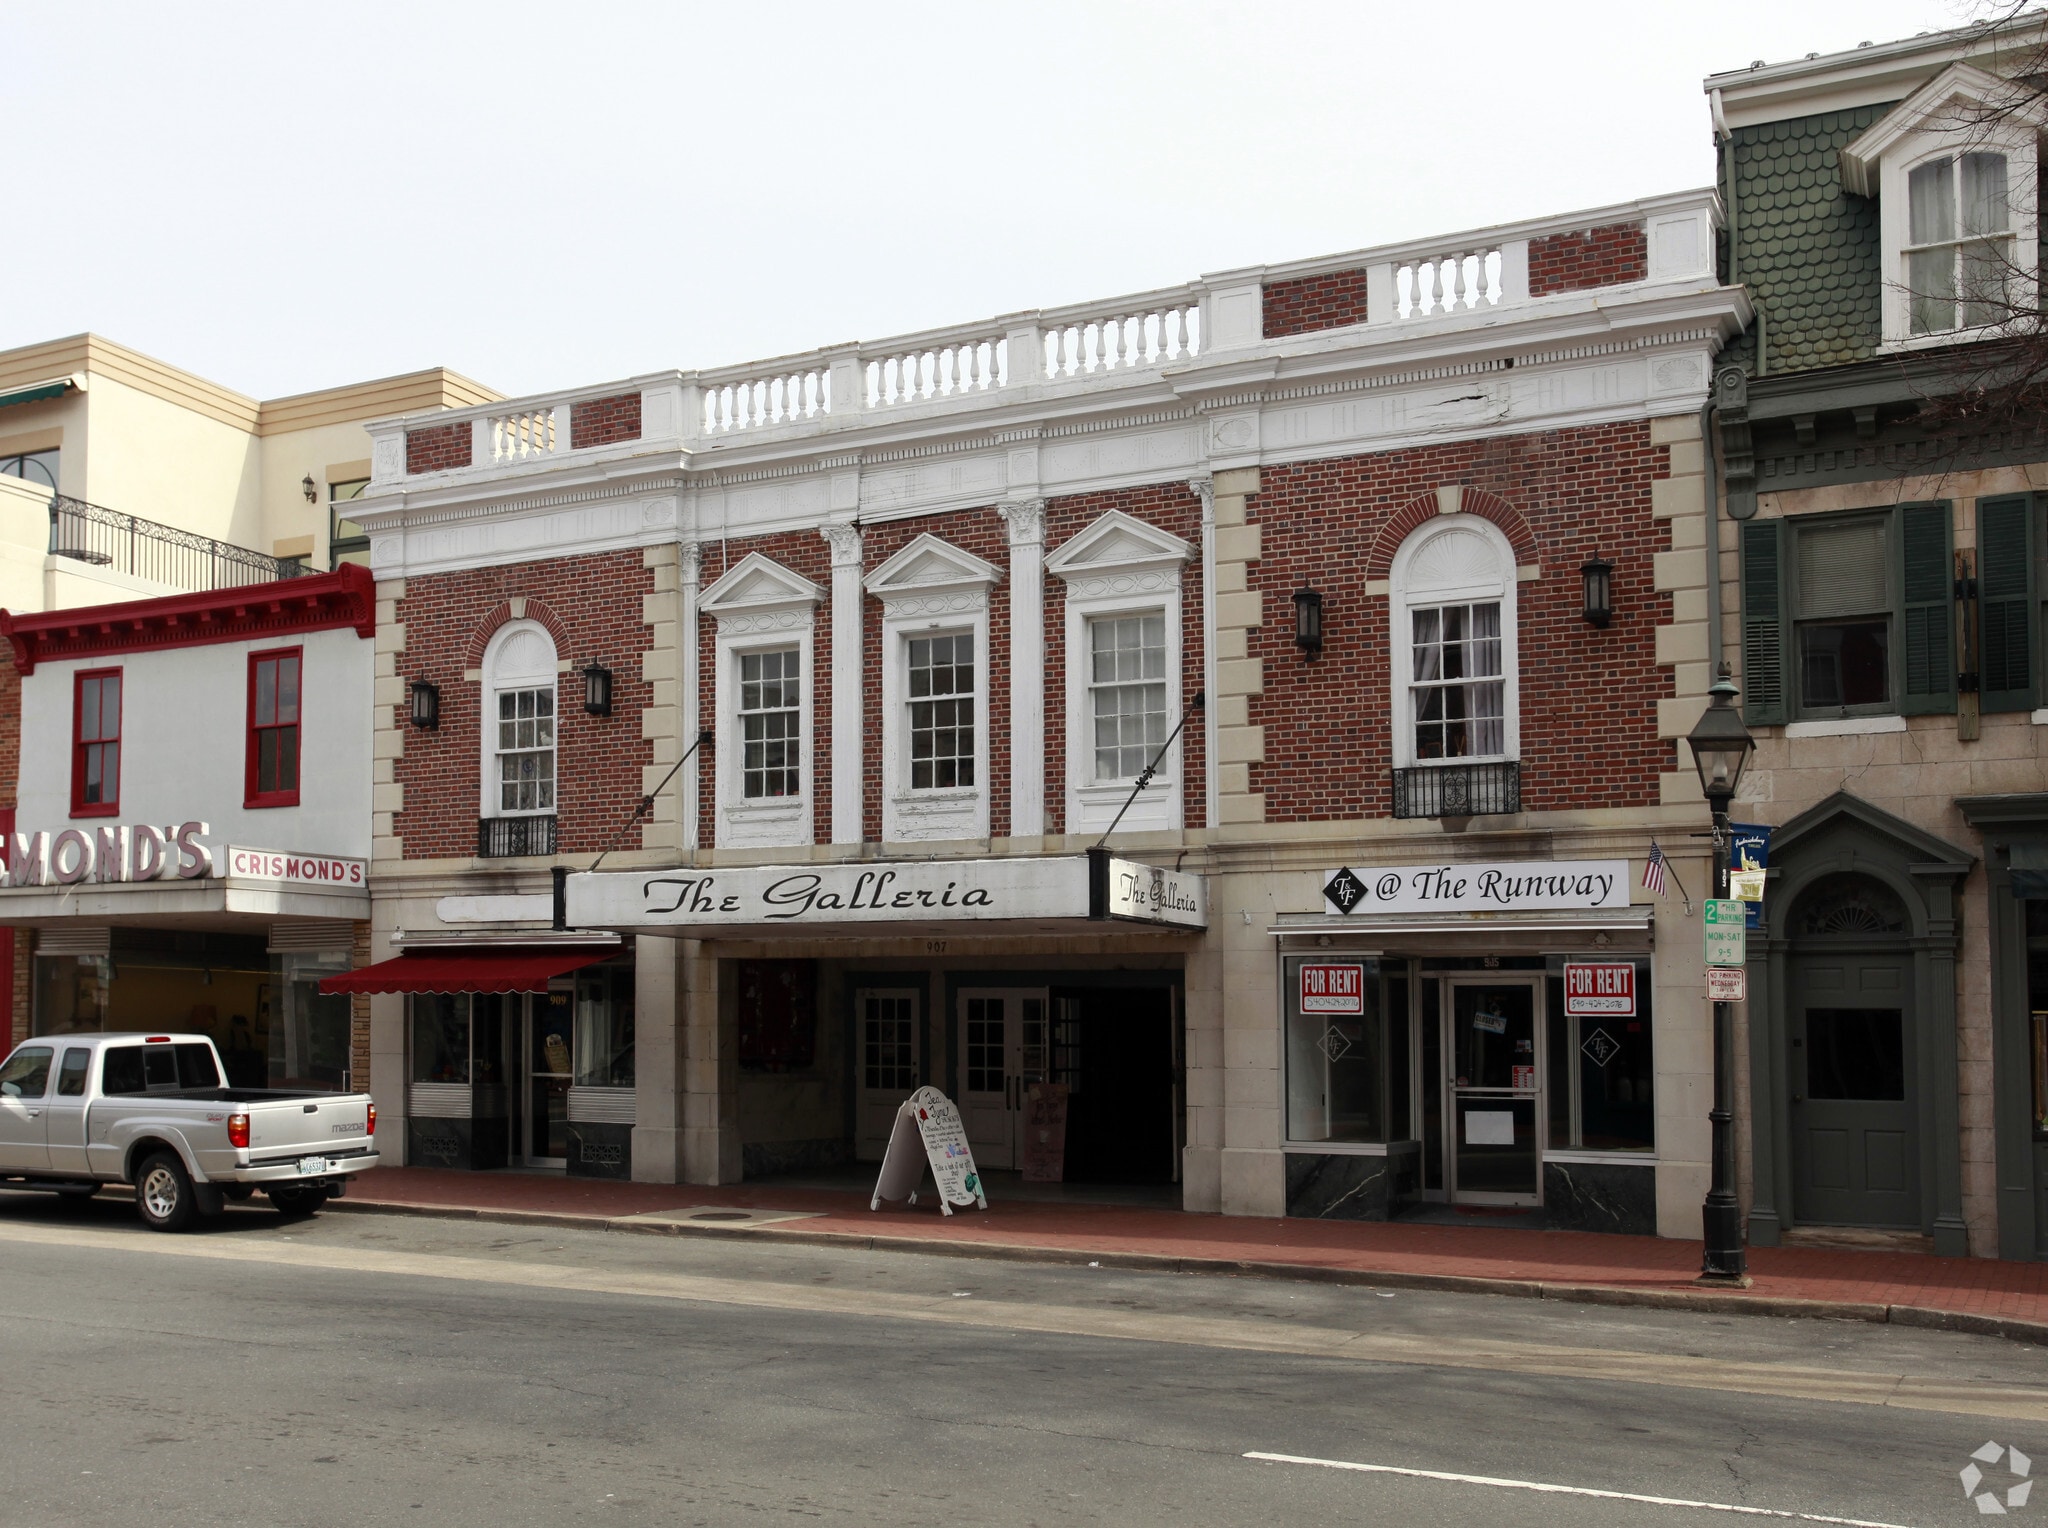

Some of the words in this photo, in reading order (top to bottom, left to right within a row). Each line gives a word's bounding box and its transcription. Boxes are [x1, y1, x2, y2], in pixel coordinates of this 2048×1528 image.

[0, 821, 213, 887] MOND'S
[235, 853, 361, 883] CRISMOND'S
[1120, 873, 1146, 904] The
[1149, 880, 1197, 912] Galleria
[1376, 873, 1402, 901] @
[1412, 867, 1467, 900] The
[1477, 870, 1613, 906] Runway
[643, 877, 741, 914] The
[762, 871, 994, 919] Galleria
[1706, 904, 1716, 920] 2
[1717, 913, 1743, 922] PARKING
[1707, 932, 1741, 941] MON-SAT
[927, 941, 947, 953] 907
[1718, 949, 1732, 957] 9-5
[1304, 969, 1326, 994] FOR
[1329, 969, 1359, 994] RENT
[1569, 968, 1593, 994] FOR
[1596, 968, 1630, 994] RENT
[1719, 972, 1741, 980] PARKING
[550, 995, 567, 1004] 909
[332, 1122, 365, 1133] mazda
